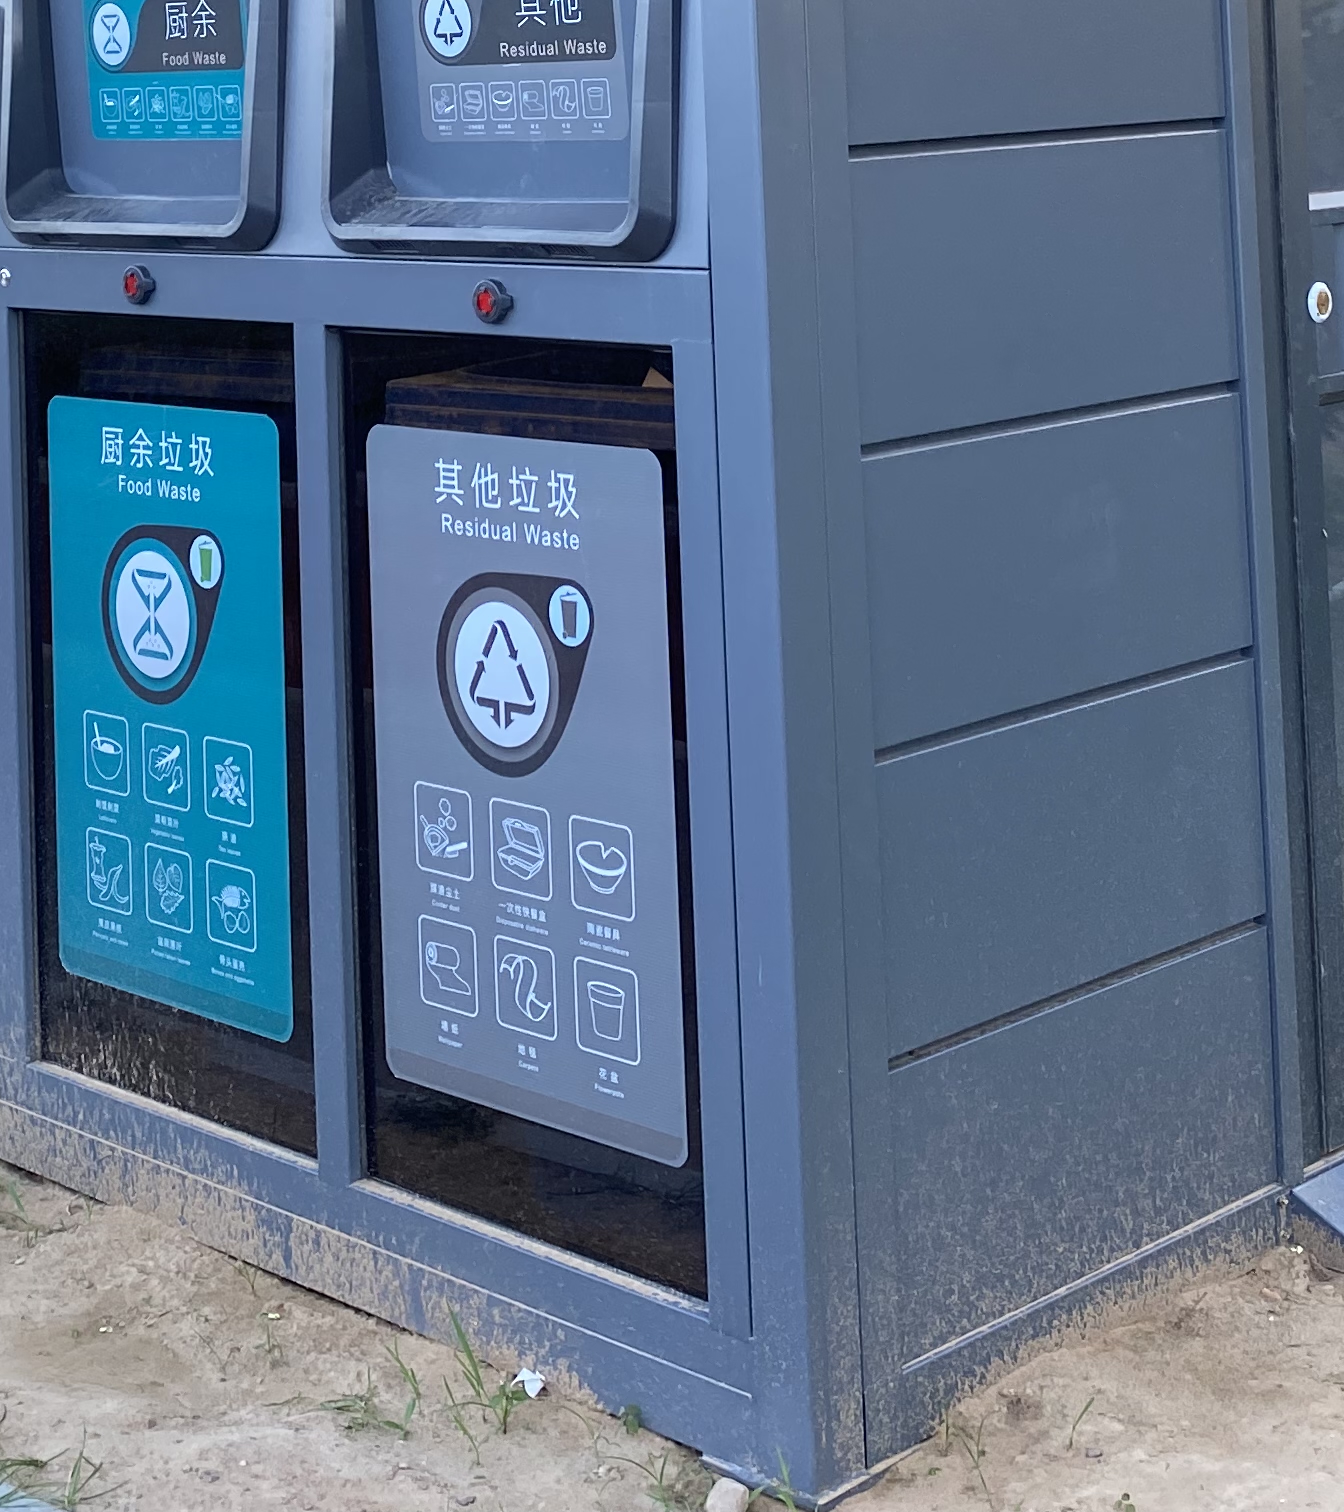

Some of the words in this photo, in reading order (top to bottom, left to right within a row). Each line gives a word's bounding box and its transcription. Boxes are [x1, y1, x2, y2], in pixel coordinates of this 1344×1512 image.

[162, 52, 189, 66] Food
[192, 51, 227, 65] Waste
[499, 40, 559, 58] Residual
[564, 38, 607, 55] Waste
[101, 426, 215, 477] 厨余垃圾
[118, 474, 152, 496] Food
[157, 478, 201, 503] Waste
[434, 457, 580, 520] 其他垃圾
[441, 512, 517, 543] Residual
[523, 522, 581, 551] Waste
